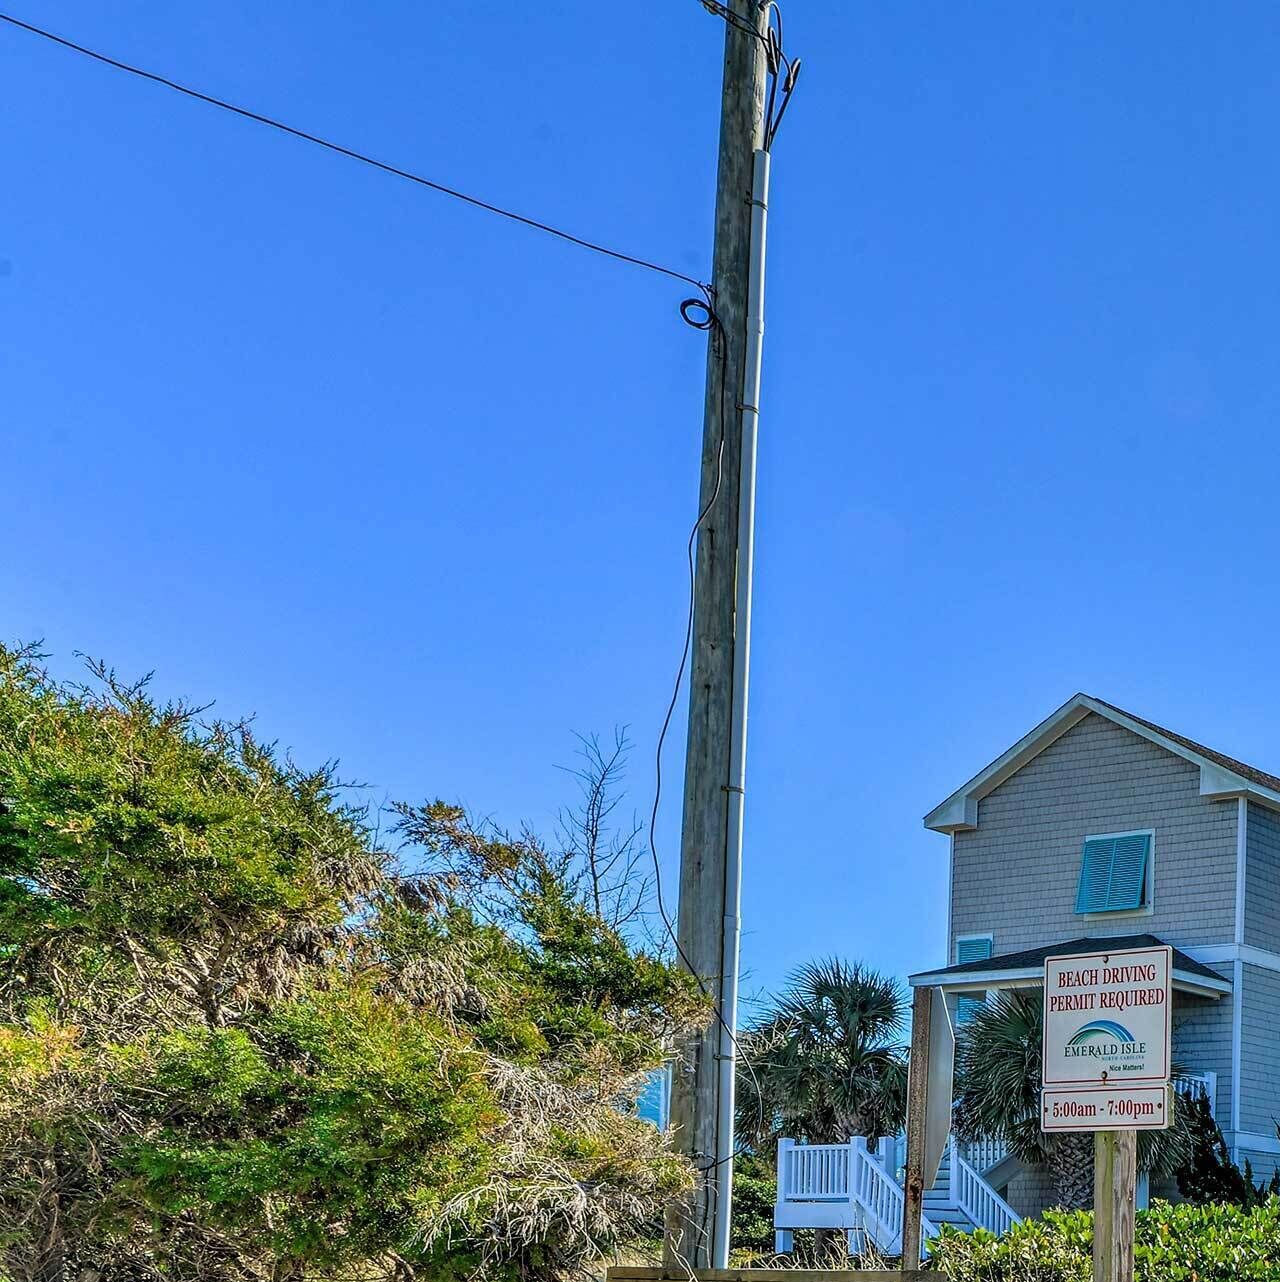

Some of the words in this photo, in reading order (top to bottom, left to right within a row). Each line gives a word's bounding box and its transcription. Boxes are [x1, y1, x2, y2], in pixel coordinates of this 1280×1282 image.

[1058, 968, 1099, 988] BEACH
[1102, 964, 1156, 985] DRIVING
[1050, 993, 1096, 1013] PERMIT
[1100, 988, 1164, 1011] REQUIRED
[1064, 1044, 1118, 1058] EMERALD
[1121, 1042, 1146, 1055] ISLE
[1122, 1063, 1145, 1071] Matters!
[1052, 1101, 1096, 1118] 5:00am
[1107, 1100, 1154, 1119] 7:00pm
